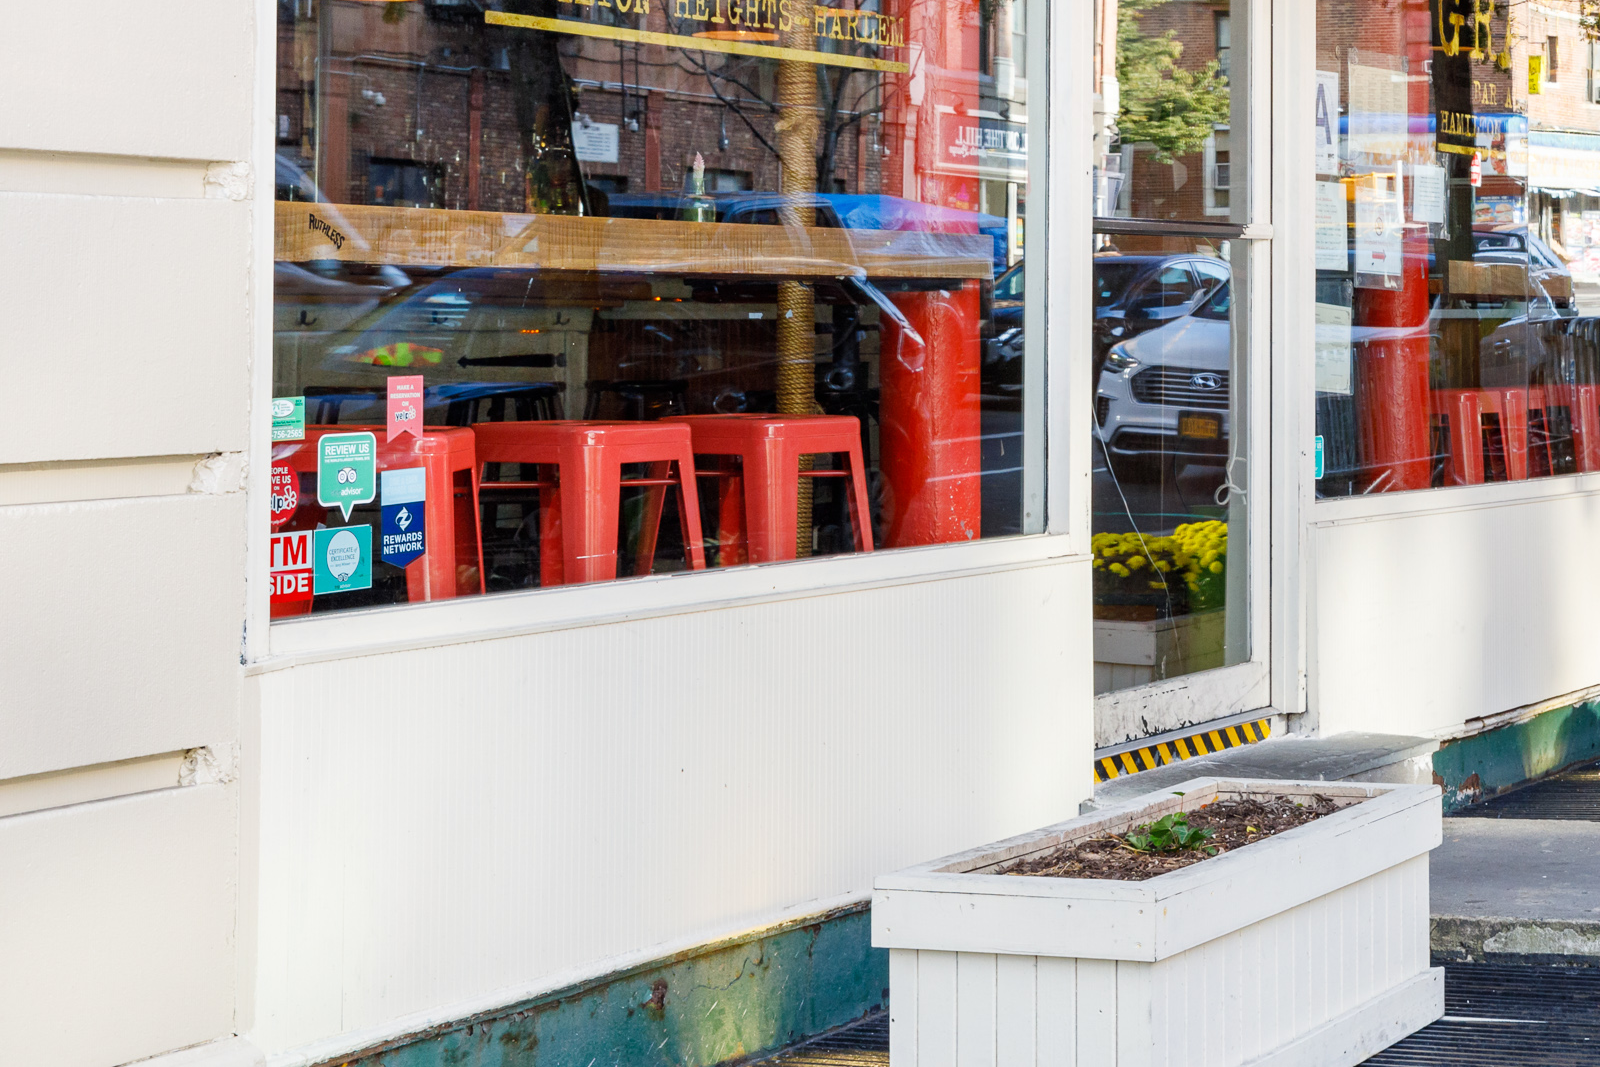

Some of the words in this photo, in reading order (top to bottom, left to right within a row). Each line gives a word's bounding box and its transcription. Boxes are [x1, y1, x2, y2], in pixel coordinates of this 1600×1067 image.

[1316, 83, 1332, 145] A
[308, 213, 345, 250] RUTHLESS
[395, 409, 409, 422] yelp
[325, 444, 357, 456] REVIEW
[359, 443, 370, 453] US
[271, 467, 288, 475] OPLE
[271, 476, 280, 484] VE
[282, 475, 291, 484] US
[383, 532, 423, 546] REWARDS
[270, 534, 308, 568] TM
[328, 546, 354, 556] CERTIFICATE
[330, 554, 356, 563] EXCELLENCE
[270, 572, 309, 596] SIDE
